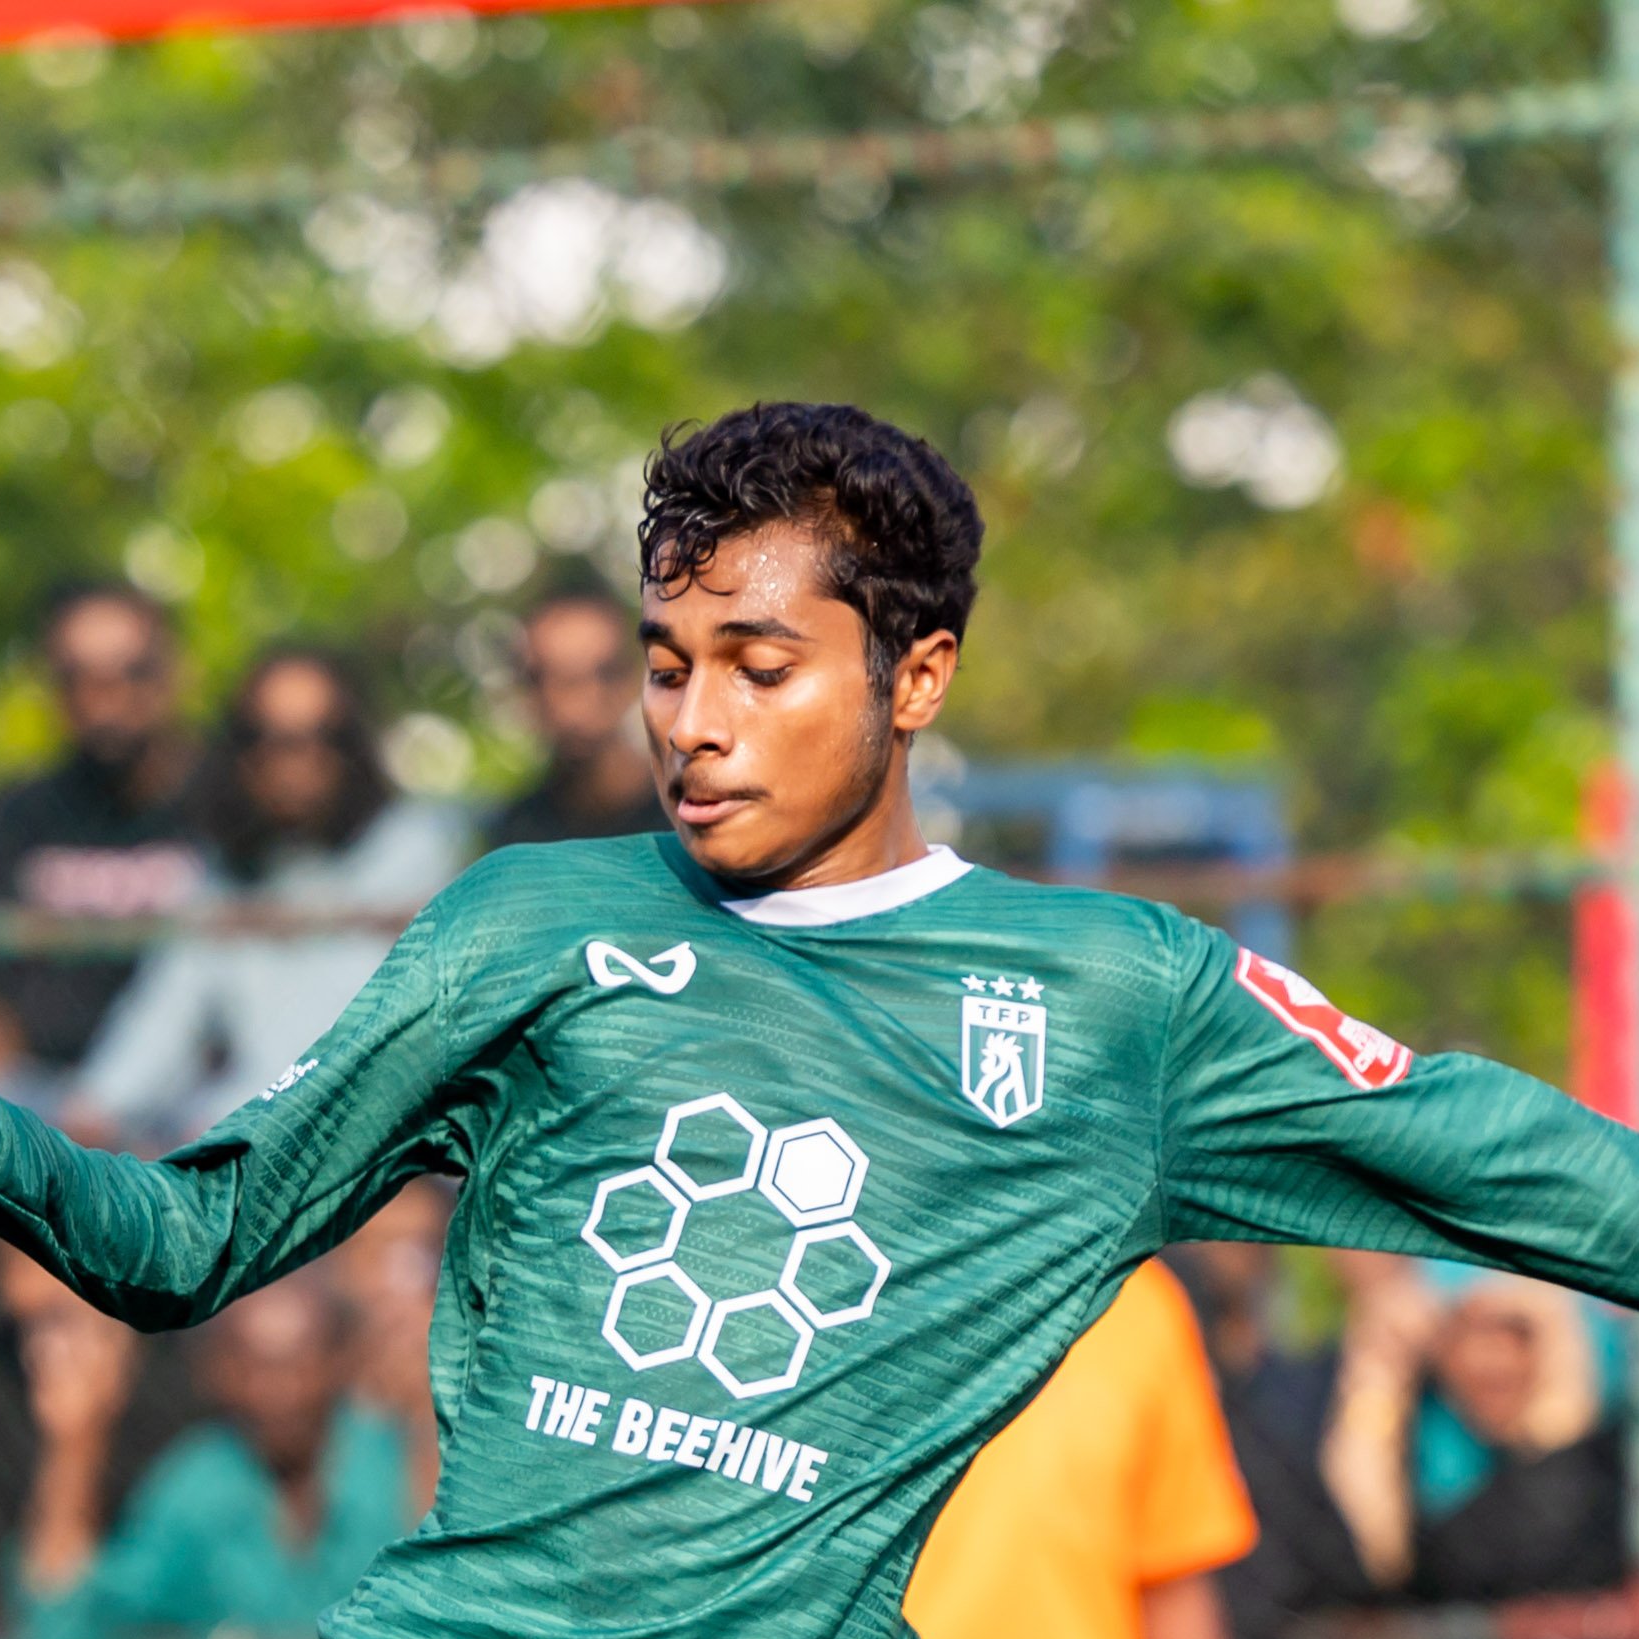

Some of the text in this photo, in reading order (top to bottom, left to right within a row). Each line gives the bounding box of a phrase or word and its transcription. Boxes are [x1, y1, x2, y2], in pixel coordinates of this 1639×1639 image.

[978, 1004, 1031, 1025] TFP
[526, 1375, 829, 1503] THE BEEHIVE
